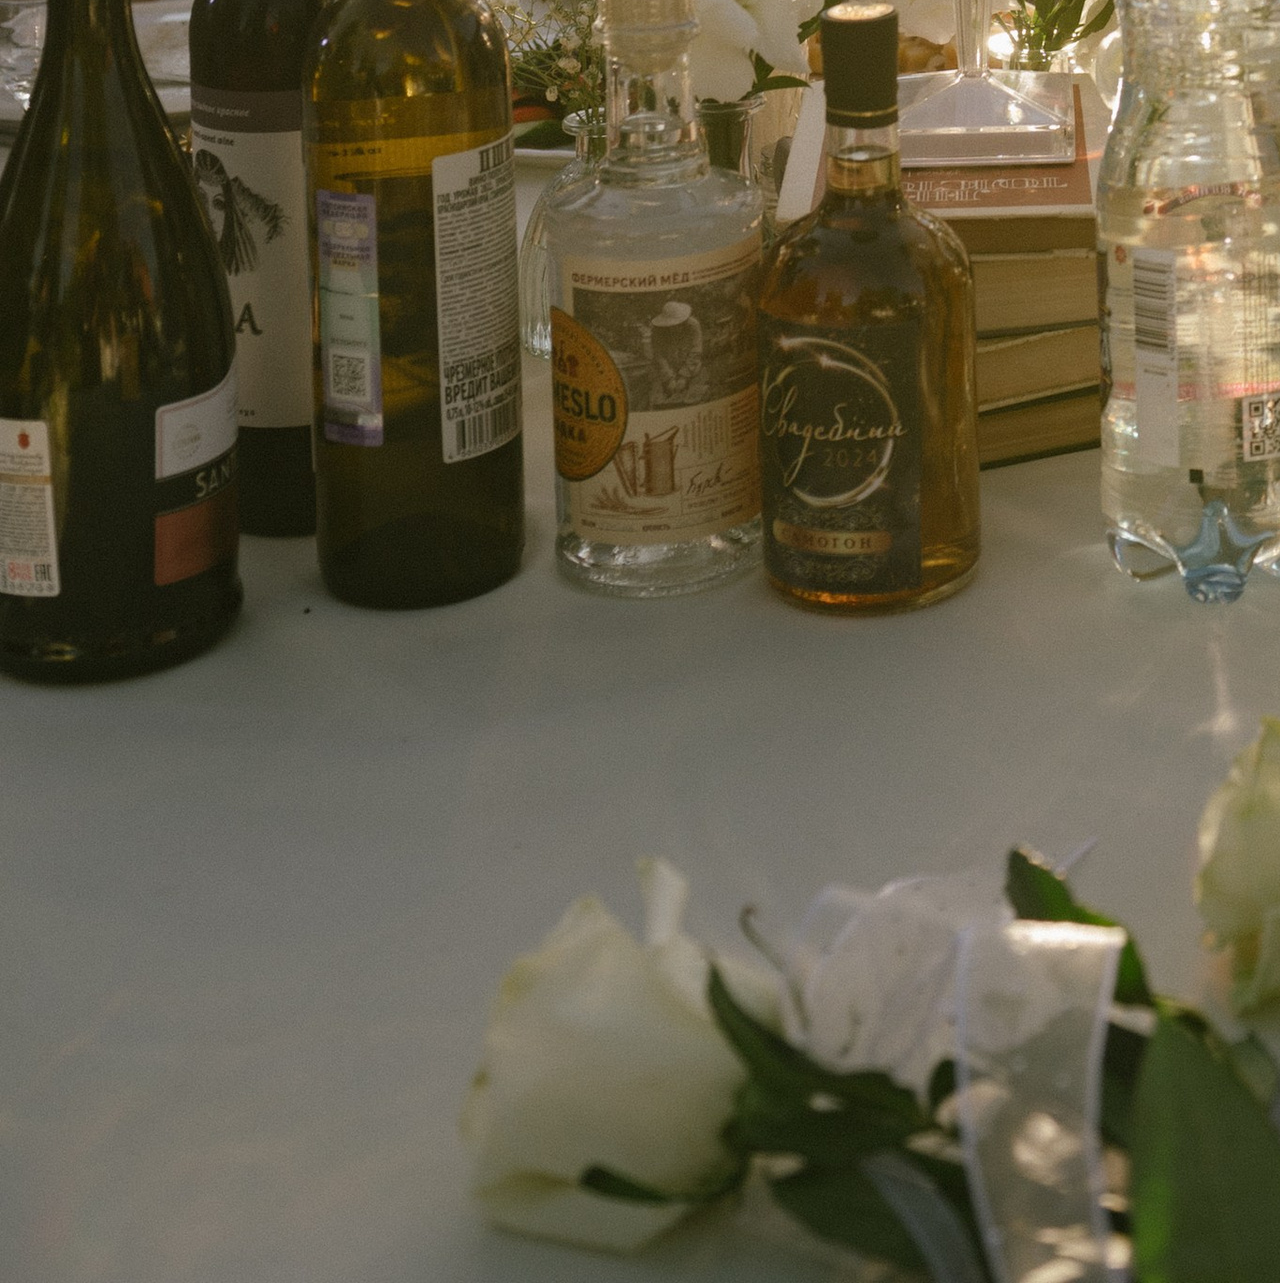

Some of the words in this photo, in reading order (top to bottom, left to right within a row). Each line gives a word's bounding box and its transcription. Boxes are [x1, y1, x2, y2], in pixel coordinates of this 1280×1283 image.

[571, 272, 657, 288] ФЕРМЕРСКИЙ
[660, 271, 690, 285] МЁД
[445, 375, 488, 405] ВРЕДИТ
[823, 448, 878, 468] 2024
